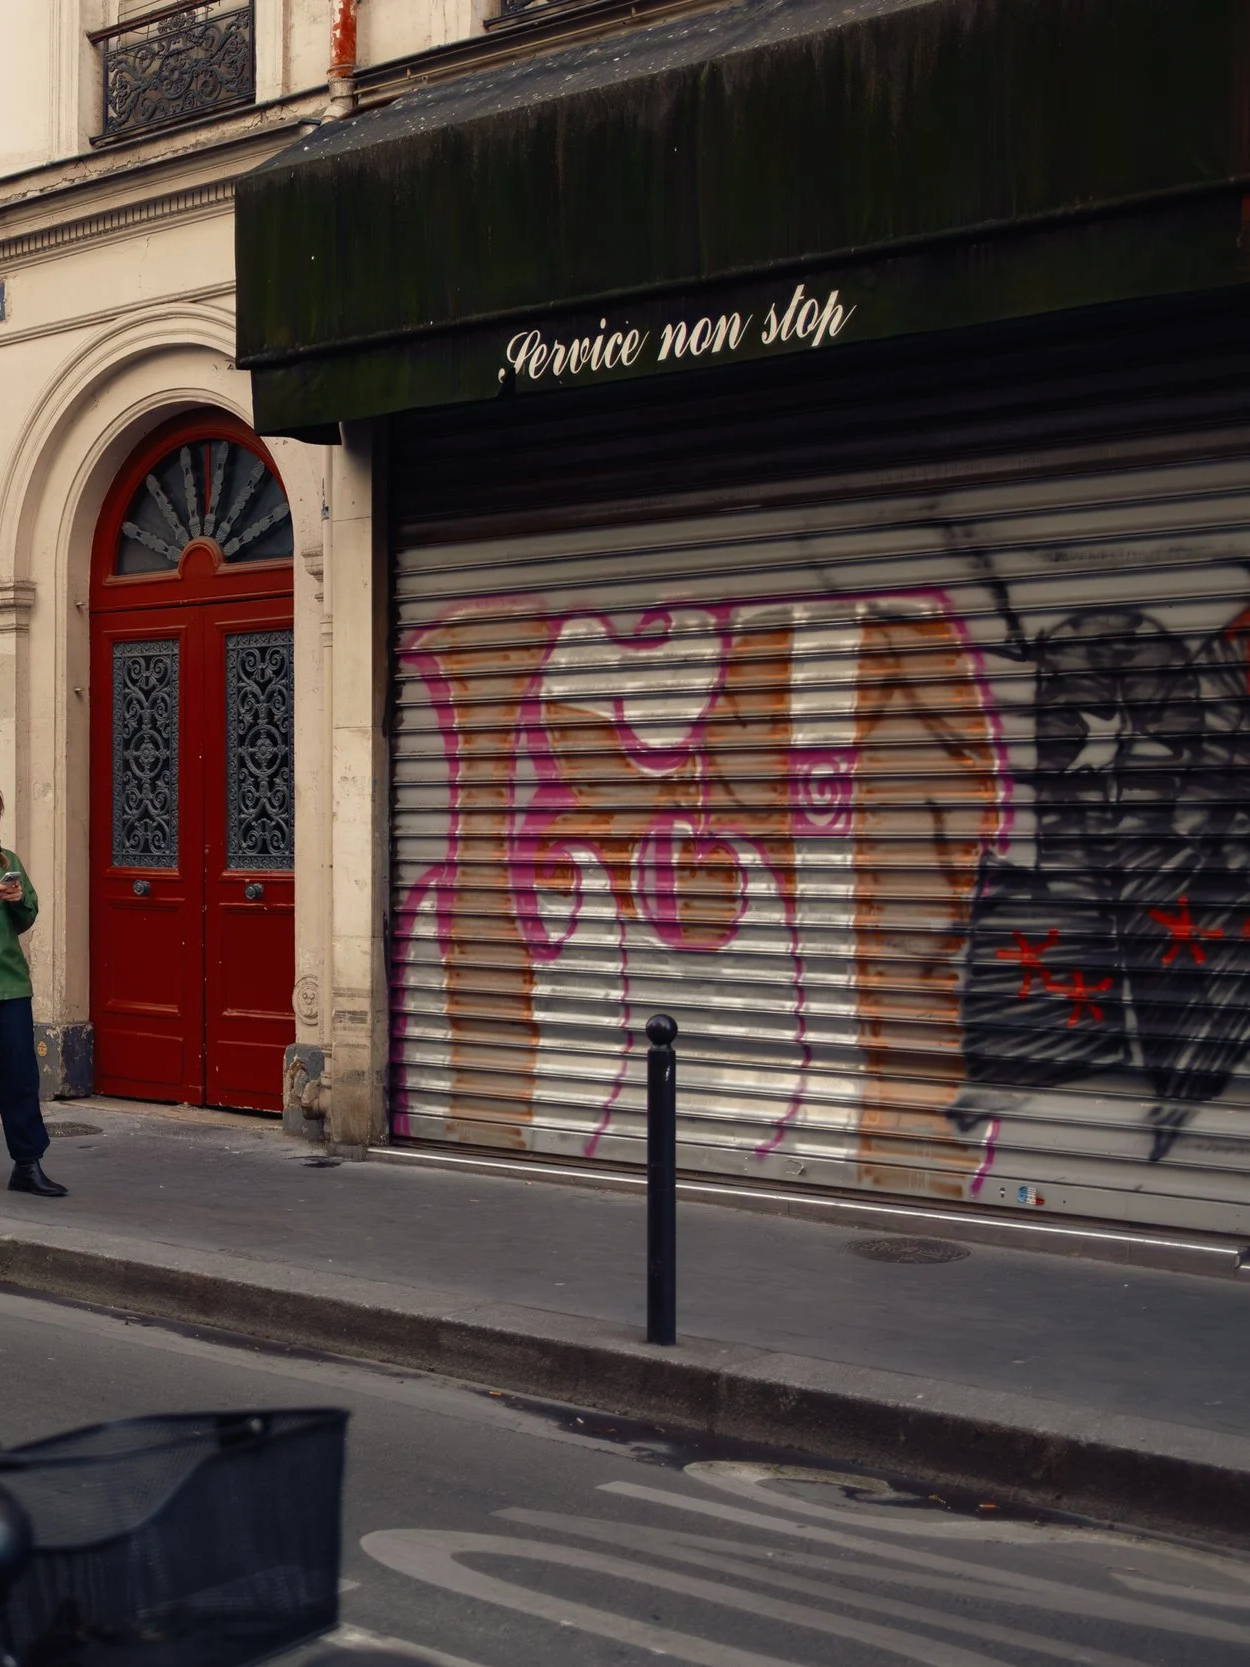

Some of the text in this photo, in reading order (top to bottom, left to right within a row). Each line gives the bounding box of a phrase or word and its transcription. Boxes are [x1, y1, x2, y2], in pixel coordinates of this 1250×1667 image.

[497, 284, 857, 384] Service non stop
